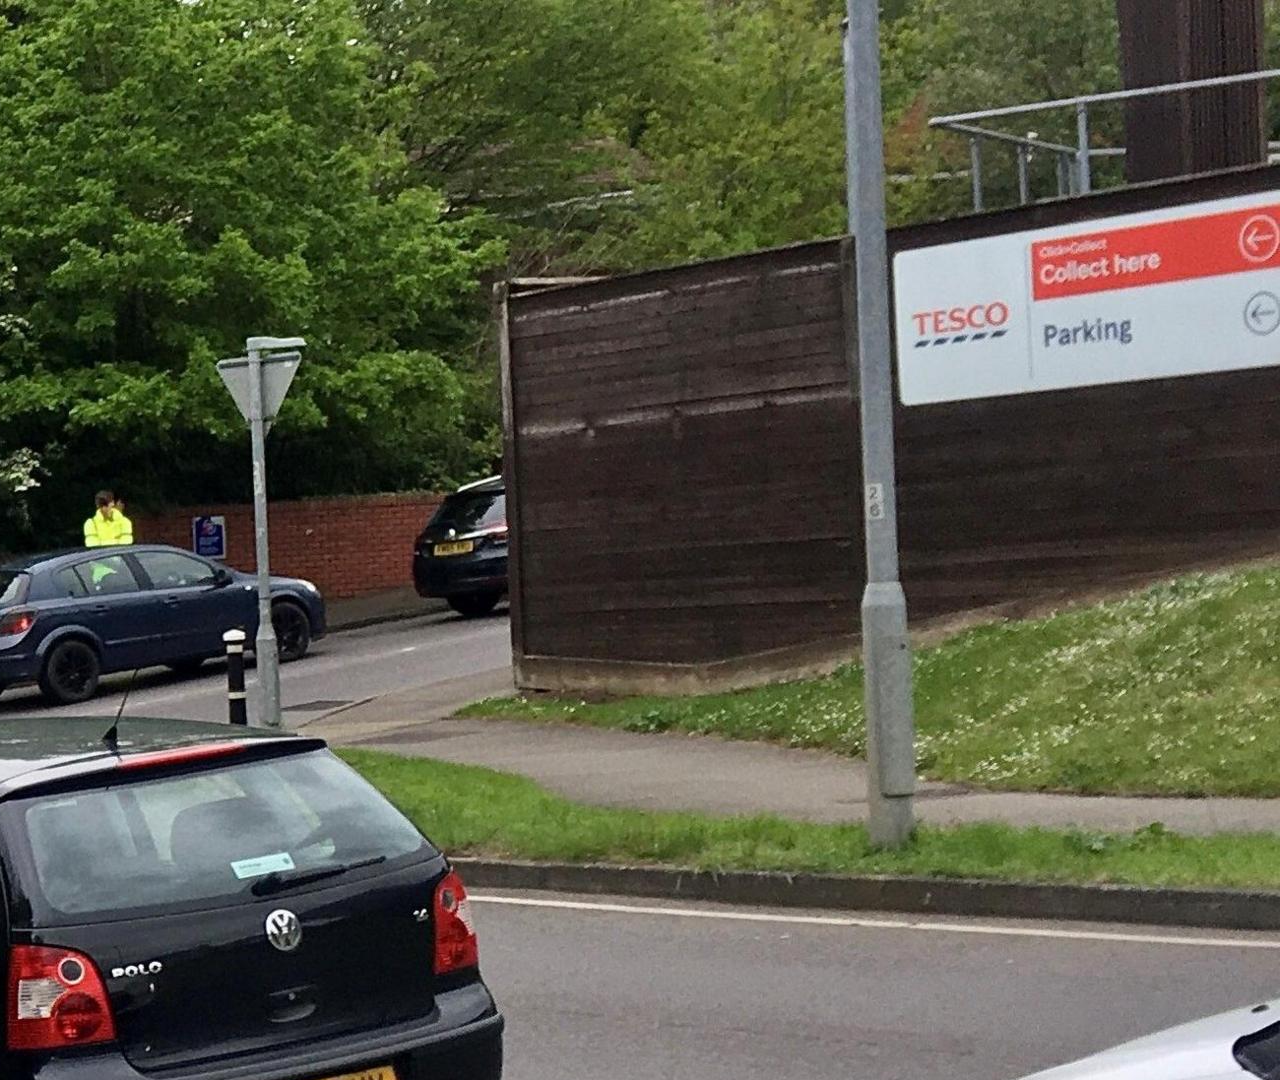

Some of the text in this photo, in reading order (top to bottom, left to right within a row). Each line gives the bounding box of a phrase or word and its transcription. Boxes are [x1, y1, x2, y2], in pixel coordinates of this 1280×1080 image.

[1040, 252, 1162, 285] Collect here
[911, 301, 1010, 336] TESCO
[1043, 317, 1133, 347] Parking
[111, 960, 163, 978] POLO
